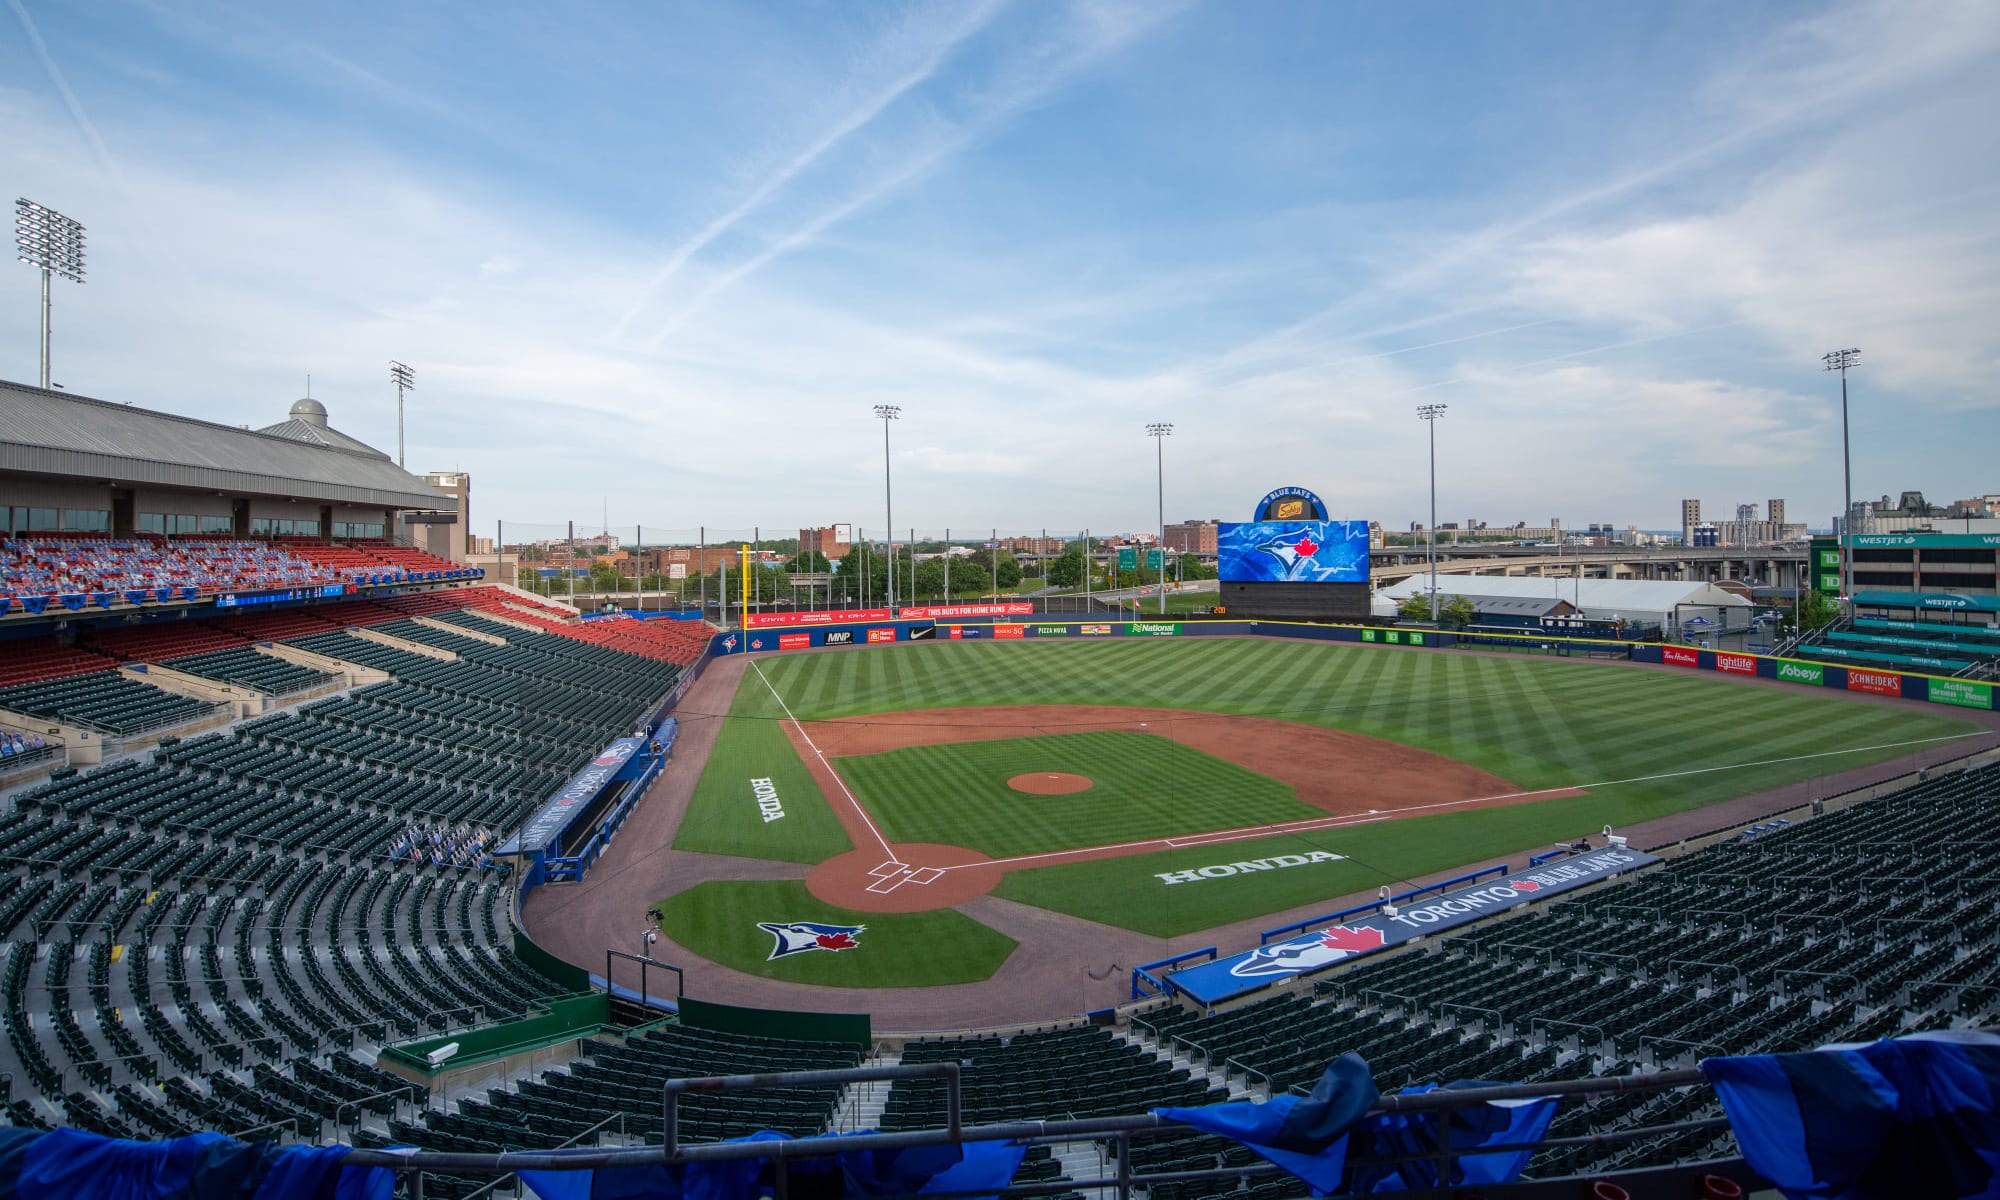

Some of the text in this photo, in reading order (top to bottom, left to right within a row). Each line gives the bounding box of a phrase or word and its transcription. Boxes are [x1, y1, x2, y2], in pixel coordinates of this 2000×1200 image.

[1269, 487, 1311, 500] BLUE JAYS
[1859, 536, 1903, 546] WESTJET
[1823, 553, 1840, 564] TD
[1823, 576, 1840, 587] TD
[1925, 598, 1957, 608] WESTJET
[928, 605, 1006, 616] THIS BUD'S FOR HOME RUNS
[1142, 624, 1175, 632] National
[828, 632, 851, 642] MNP
[1663, 650, 1696, 662] Tim Hortons
[1717, 655, 1752, 670] Lightlife
[1779, 664, 1821, 681] Sobeys
[1849, 671, 1899, 690] SCHNEIDERS
[1944, 682, 1974, 692] Active
[1930, 687, 1957, 698] Green
[1965, 692, 1988, 702] Ross
[750, 777, 785, 823] HONDA
[1154, 851, 1350, 885] HONDA
[1389, 852, 1634, 928] TORONTO BLUE JAYS
